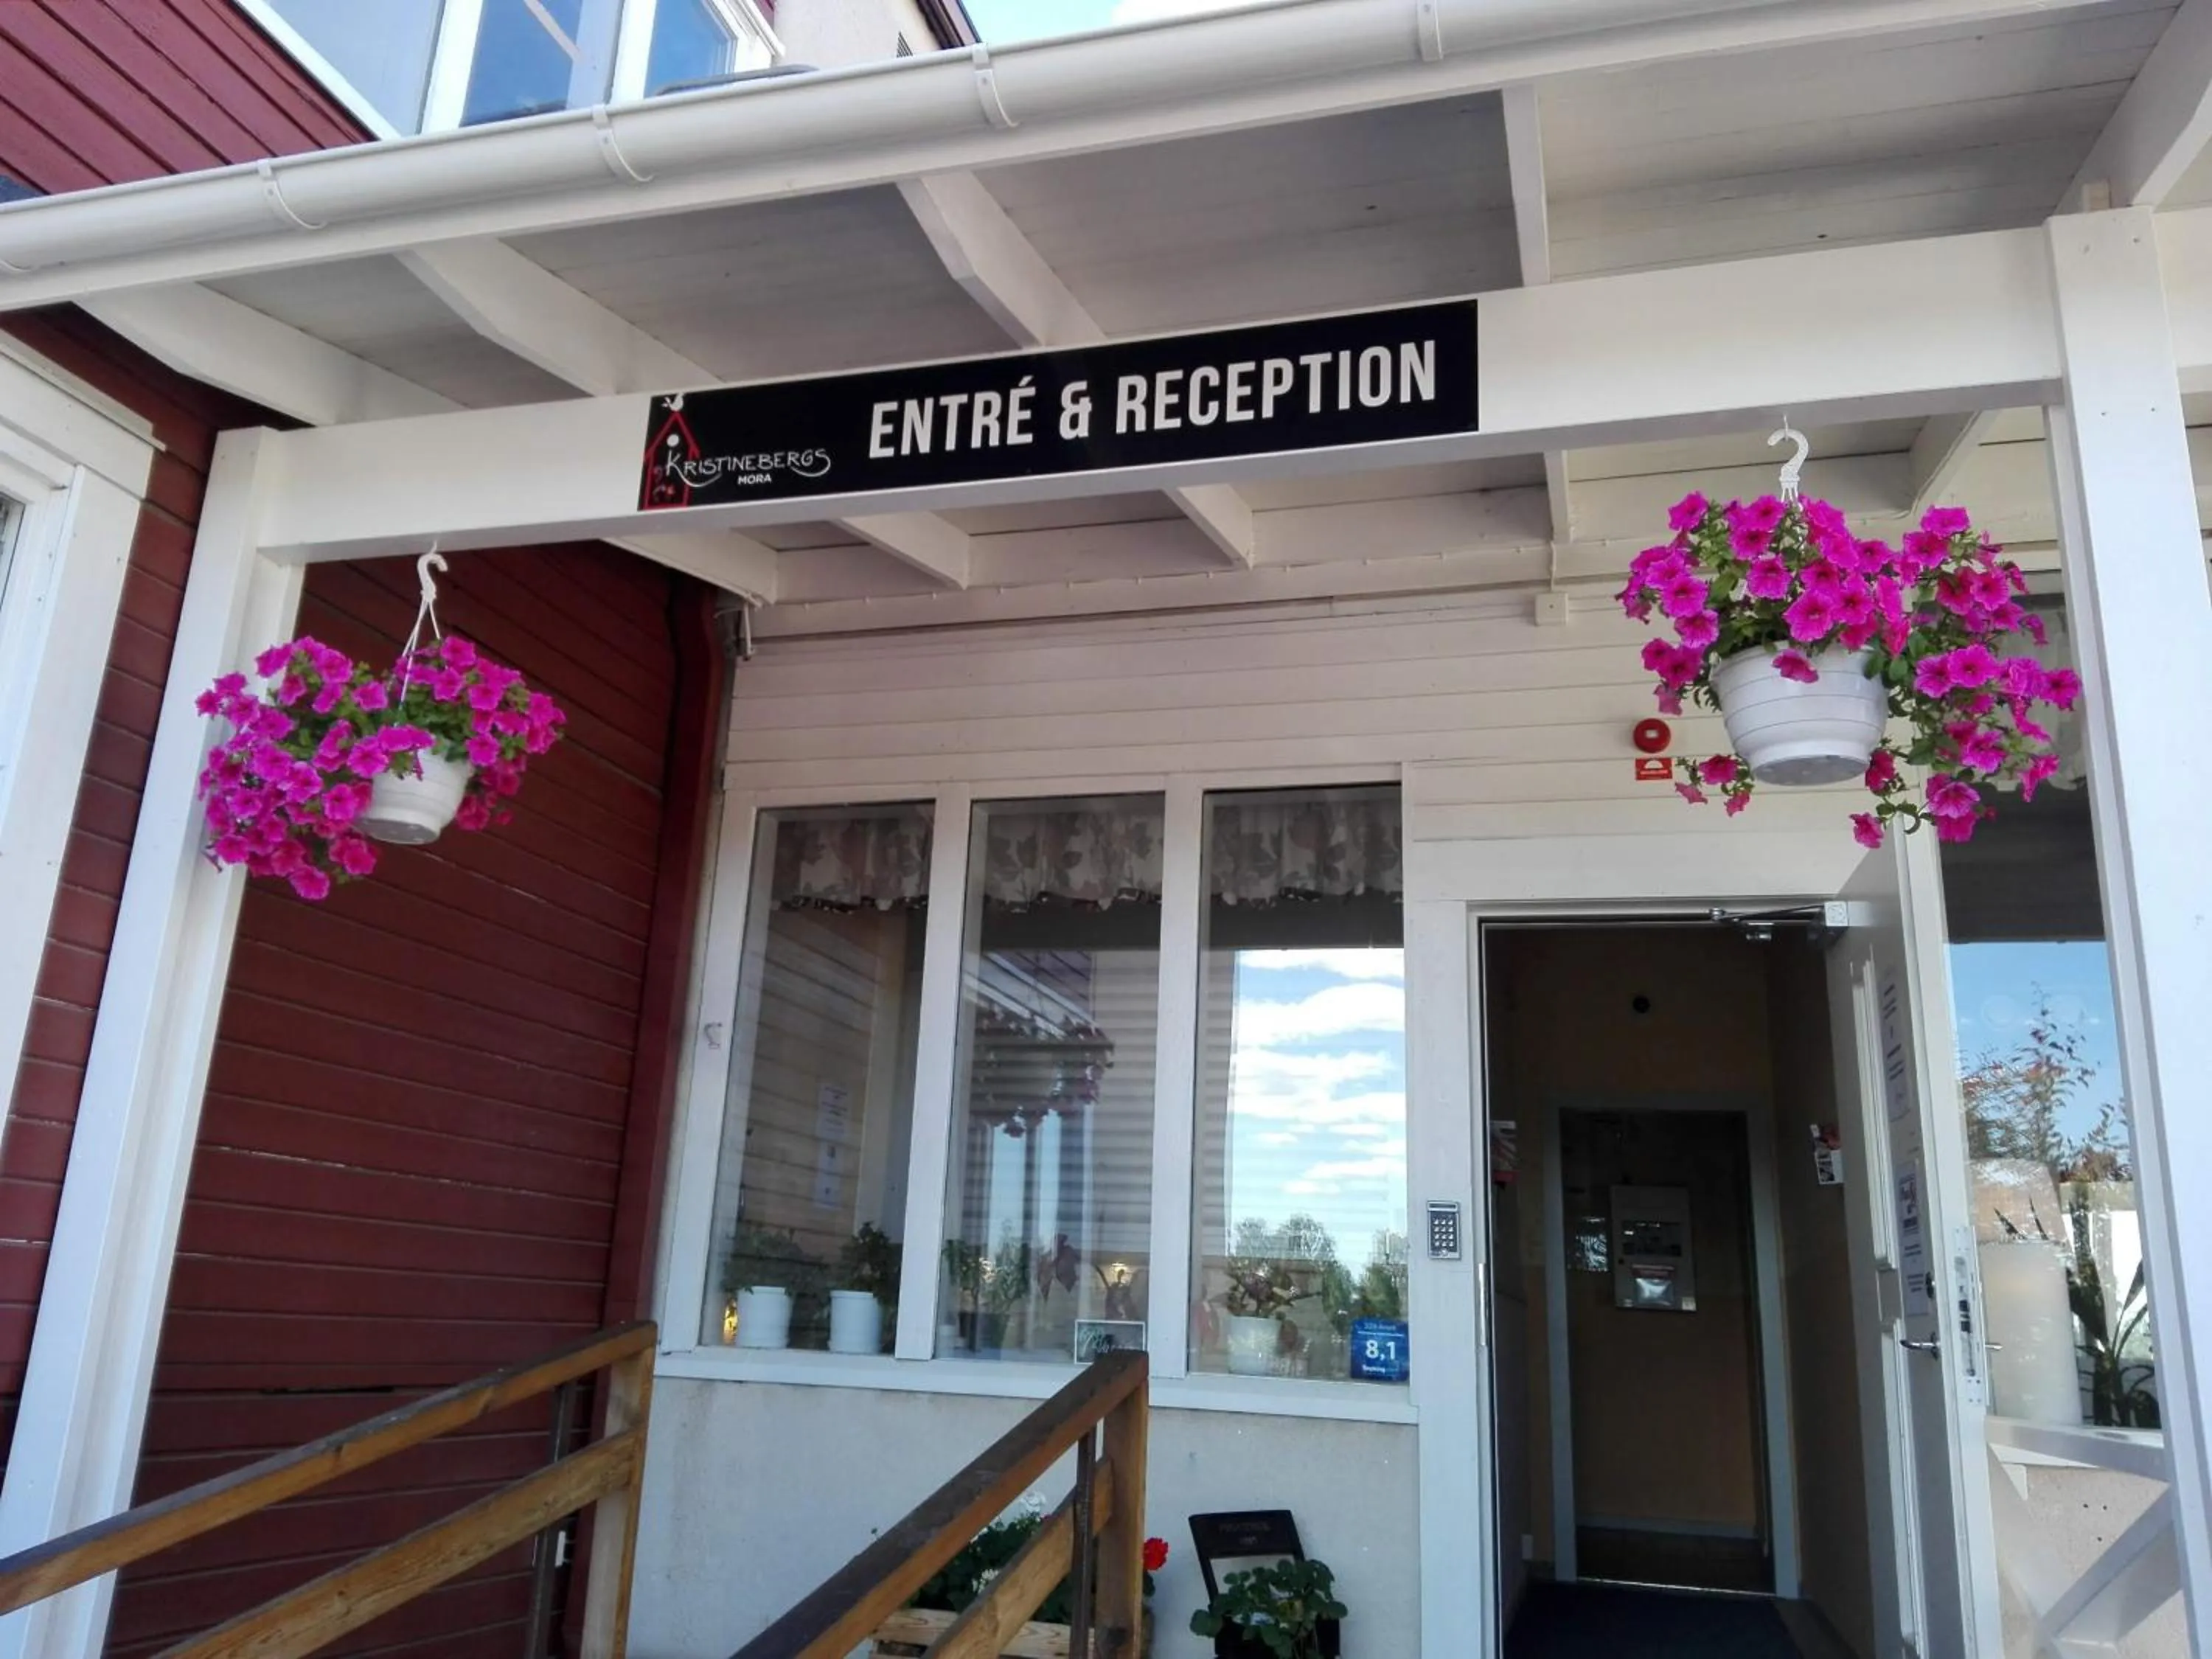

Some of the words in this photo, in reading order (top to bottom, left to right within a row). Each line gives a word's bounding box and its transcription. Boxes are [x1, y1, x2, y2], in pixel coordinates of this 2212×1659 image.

[869, 375, 1036, 459] ENTRÉ
[1059, 380, 1093, 440] &
[1116, 340, 1436, 434] RECEPTION
[666, 448, 831, 487] KRISTINEBERGS
[737, 473, 772, 484] MORA
[1366, 1340, 1395, 1360] 8,1
